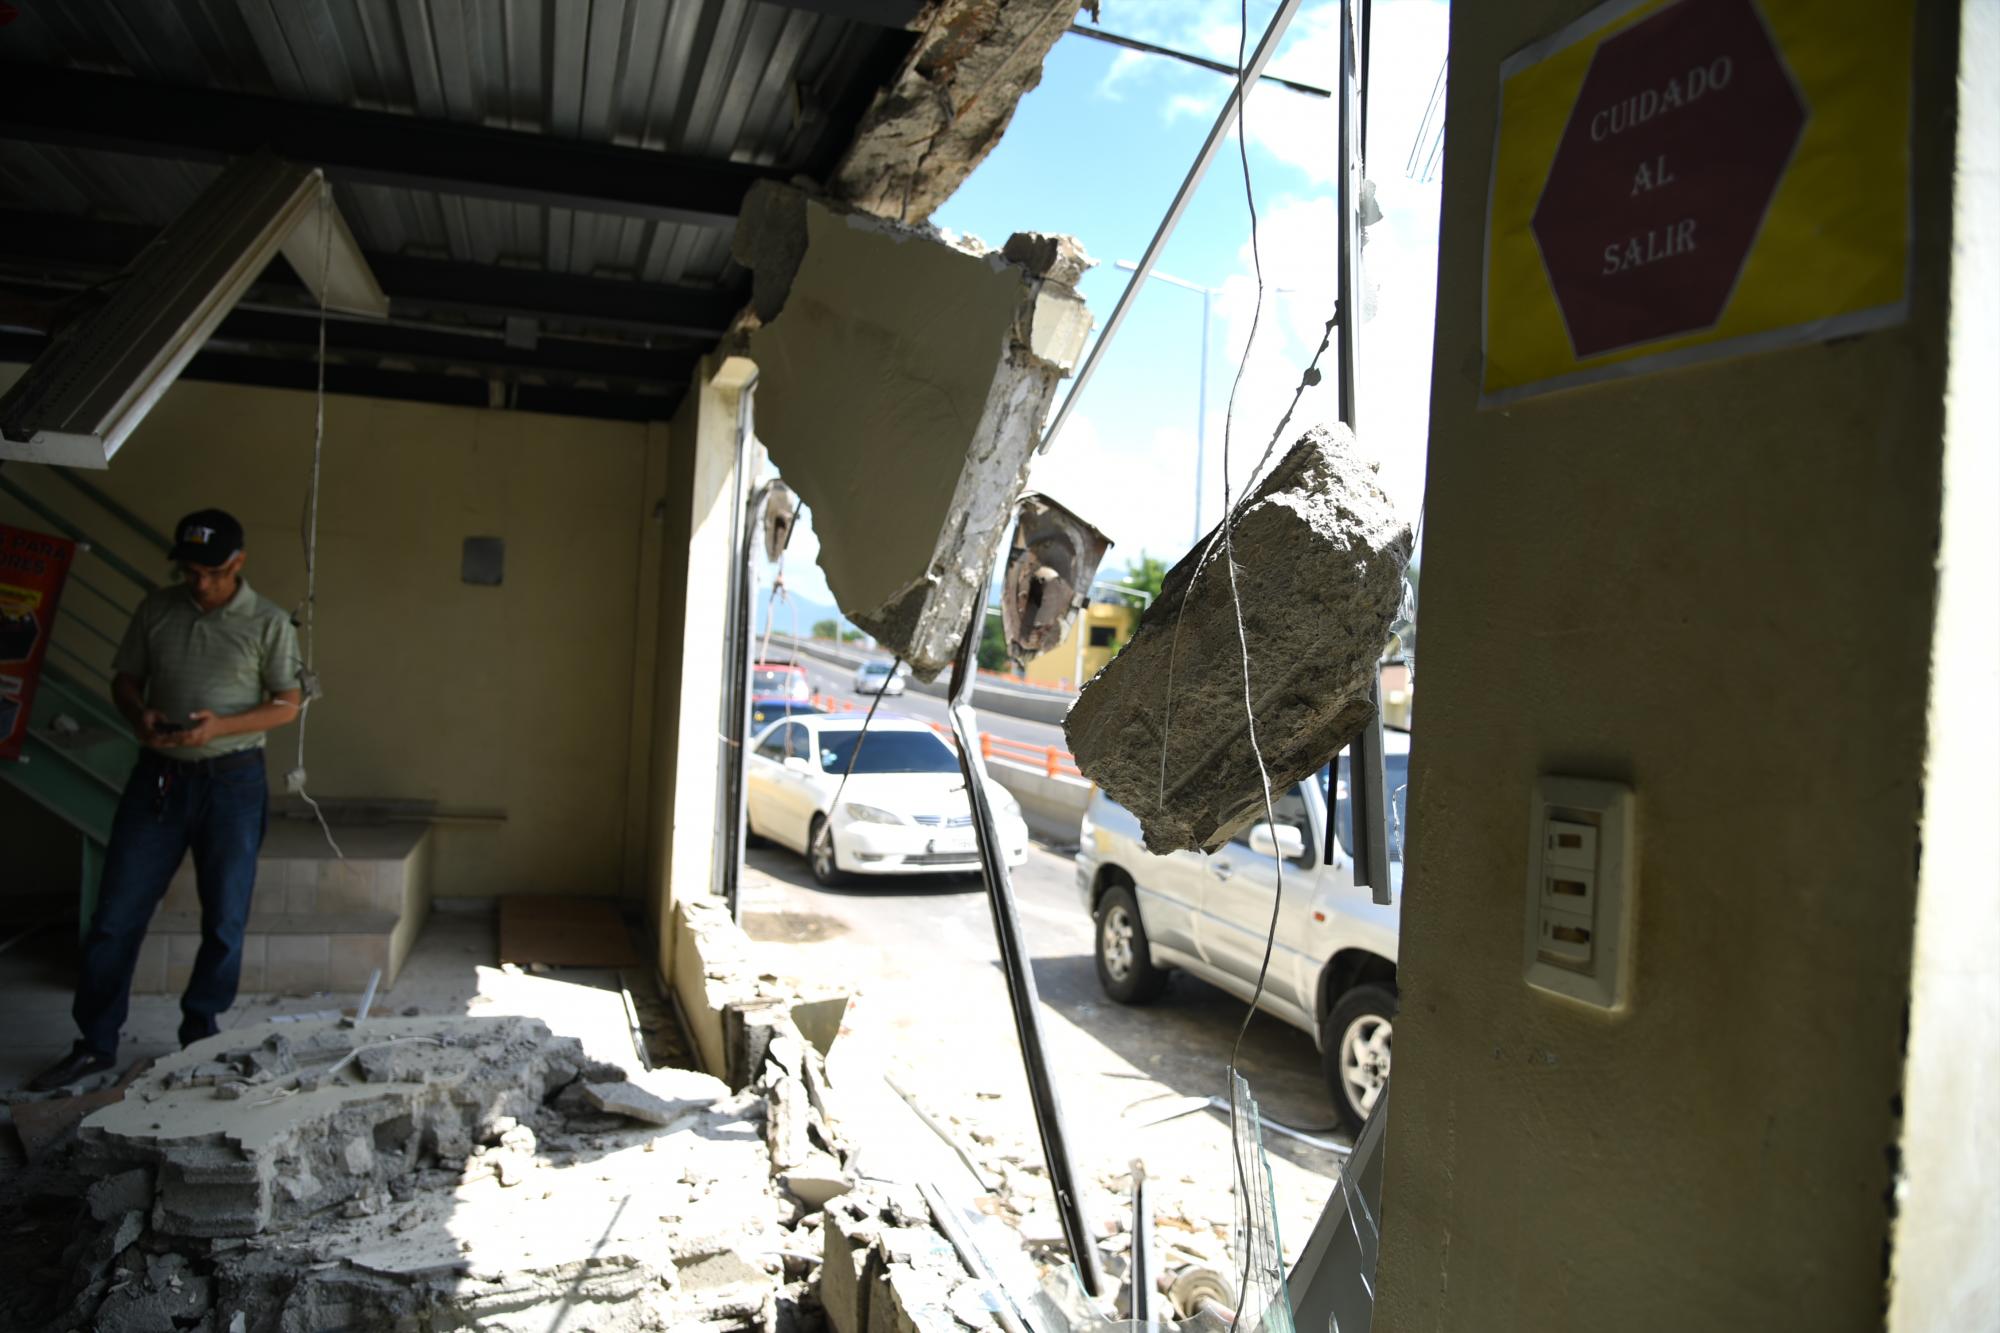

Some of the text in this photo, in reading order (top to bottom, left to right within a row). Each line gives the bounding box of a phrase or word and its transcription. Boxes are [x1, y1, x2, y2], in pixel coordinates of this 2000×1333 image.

[1590, 56, 1733, 142] CUIDADO
[1630, 154, 1675, 196] AL
[1602, 218, 1697, 275] SALIR
